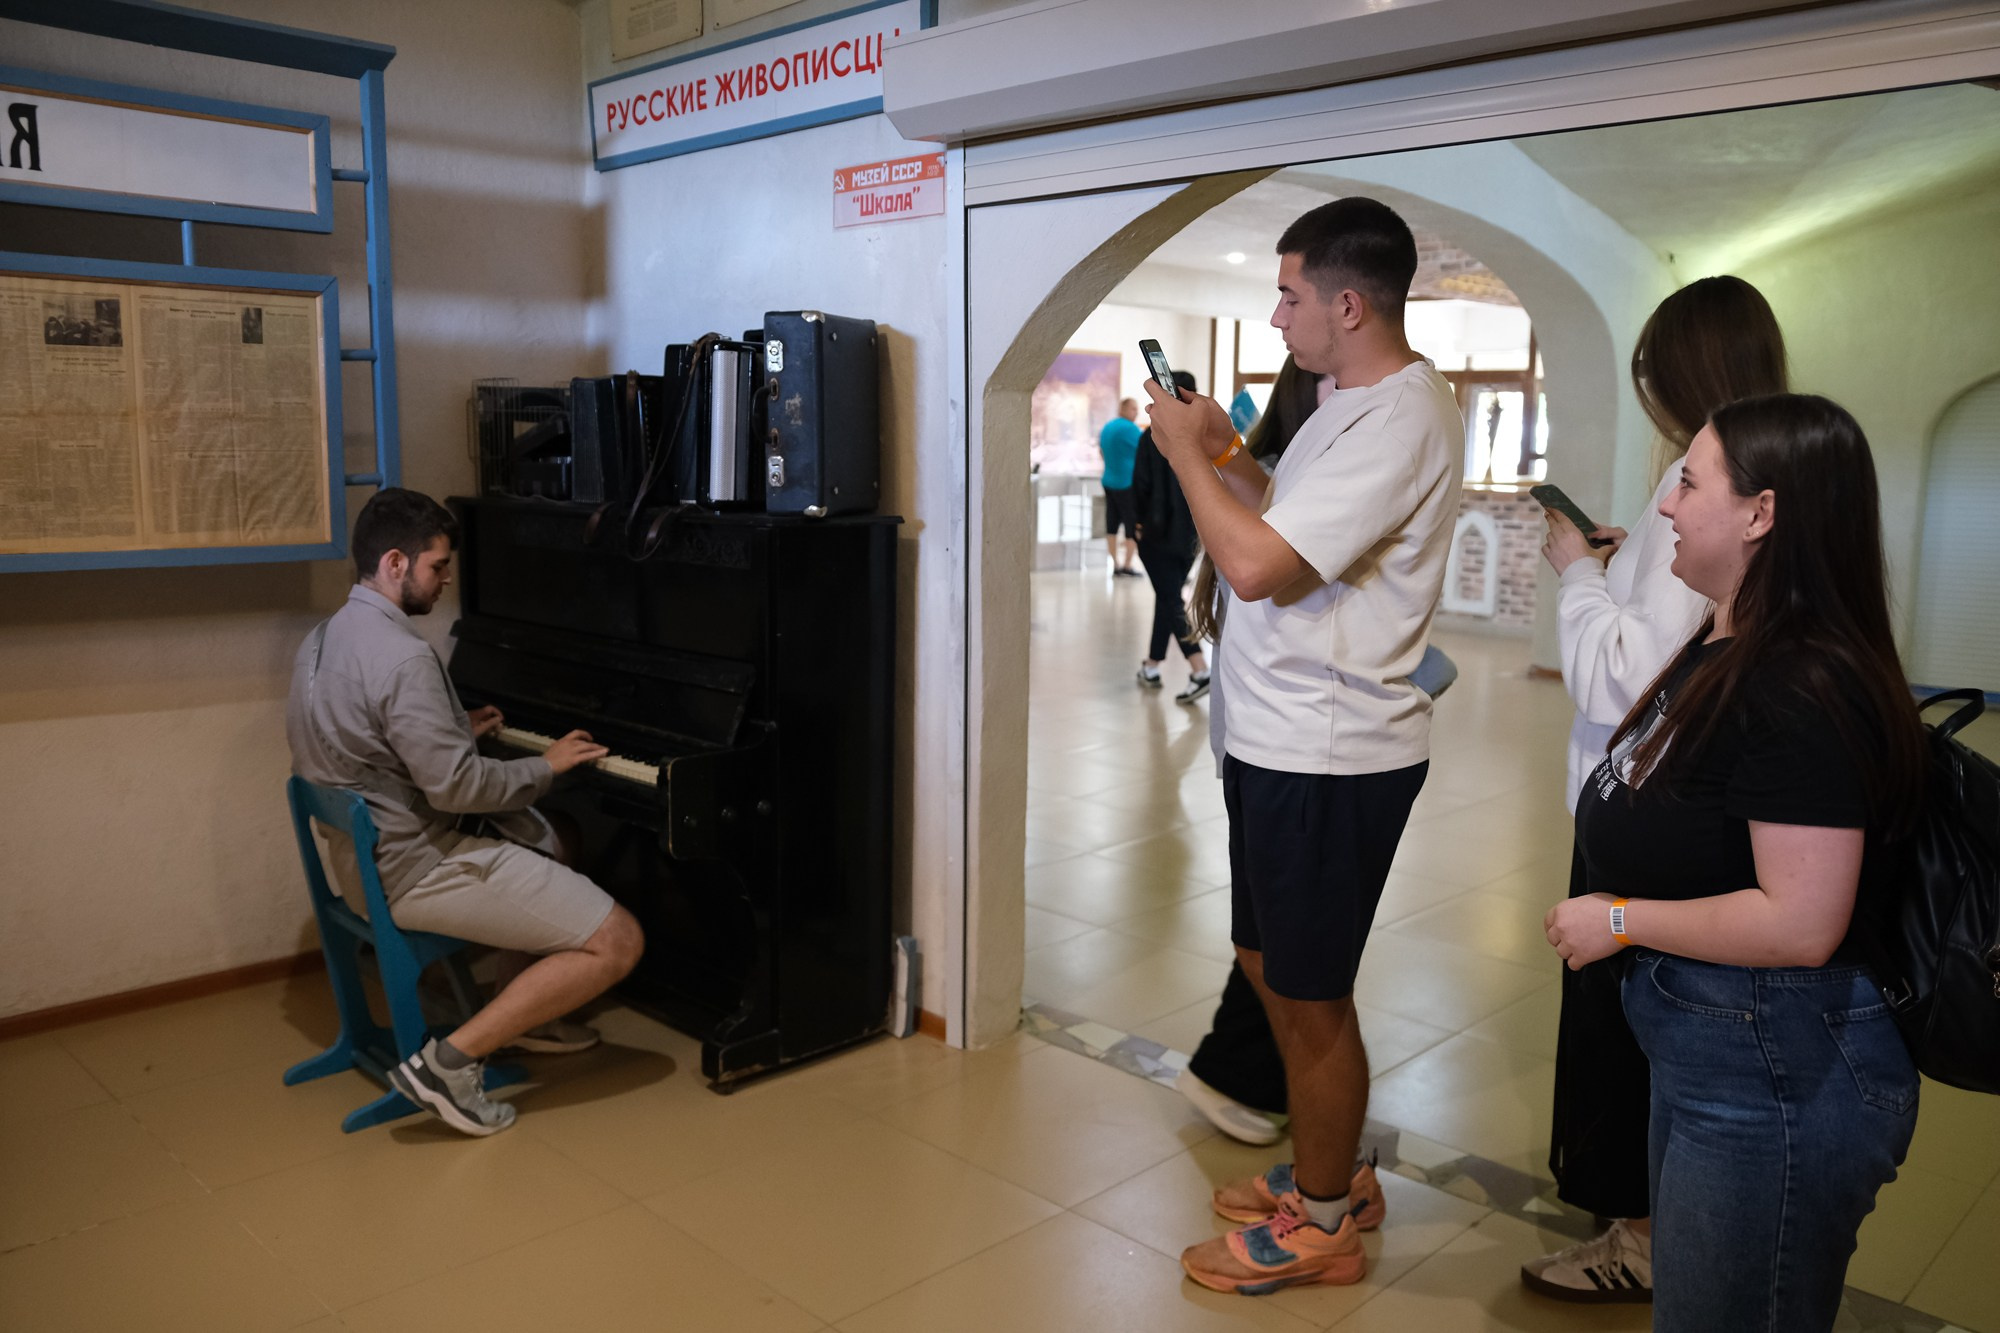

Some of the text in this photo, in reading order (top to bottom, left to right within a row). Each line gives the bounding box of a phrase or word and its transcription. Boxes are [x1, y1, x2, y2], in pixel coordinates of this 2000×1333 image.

[607, 78, 707, 133] РУССКИЕ
[0, 103, 43, 172] Я
[852, 163, 889, 188] МУЗЕЙ
[892, 161, 922, 182] СССР
